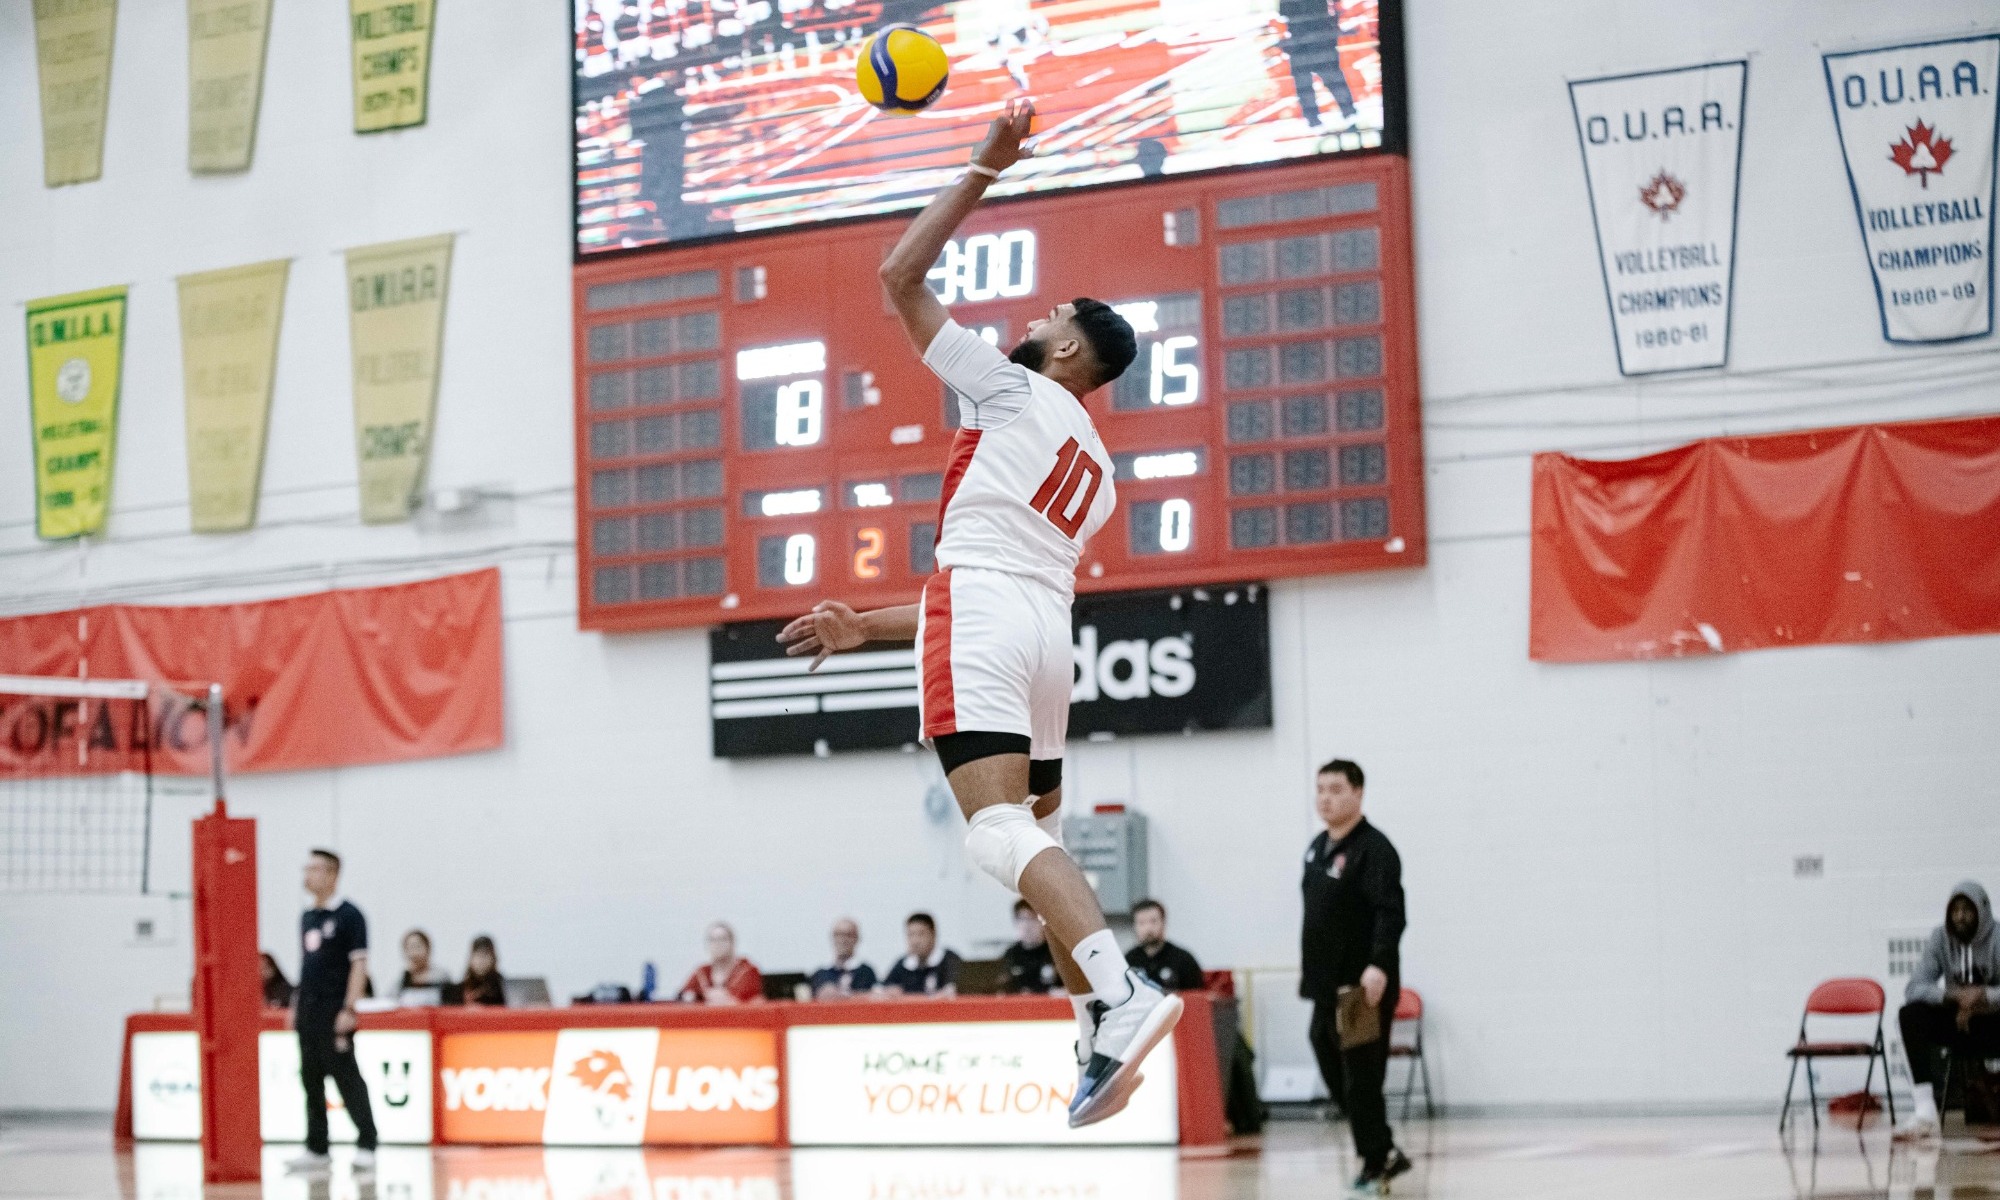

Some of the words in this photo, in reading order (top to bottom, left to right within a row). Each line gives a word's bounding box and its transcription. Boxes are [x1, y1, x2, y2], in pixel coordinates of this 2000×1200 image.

[1844, 61, 1988, 108] O.U.A.A.
[1587, 102, 1734, 145] O.U.A.A.
[1868, 196, 1982, 232] VOLLEYBALL
[1614, 243, 1721, 275] VOLLEYBALL
[1878, 239, 1982, 270] CHAMPIONS
[1618, 282, 1722, 315] CHAMPIONS
[1149, 335, 1199, 404] 15
[776, 379, 822, 446] 18
[1030, 436, 1102, 540] 10
[1160, 498, 1191, 552] 0
[784, 533, 815, 584] 0
[854, 527, 884, 578] 2
[1070, 624, 1196, 703] das
[863, 1051, 948, 1075] HOME
[441, 1067, 550, 1111] YORK
[651, 1065, 779, 1111] LIONS
[864, 1083, 967, 1114] YORK
[980, 1082, 1073, 1114] LION
